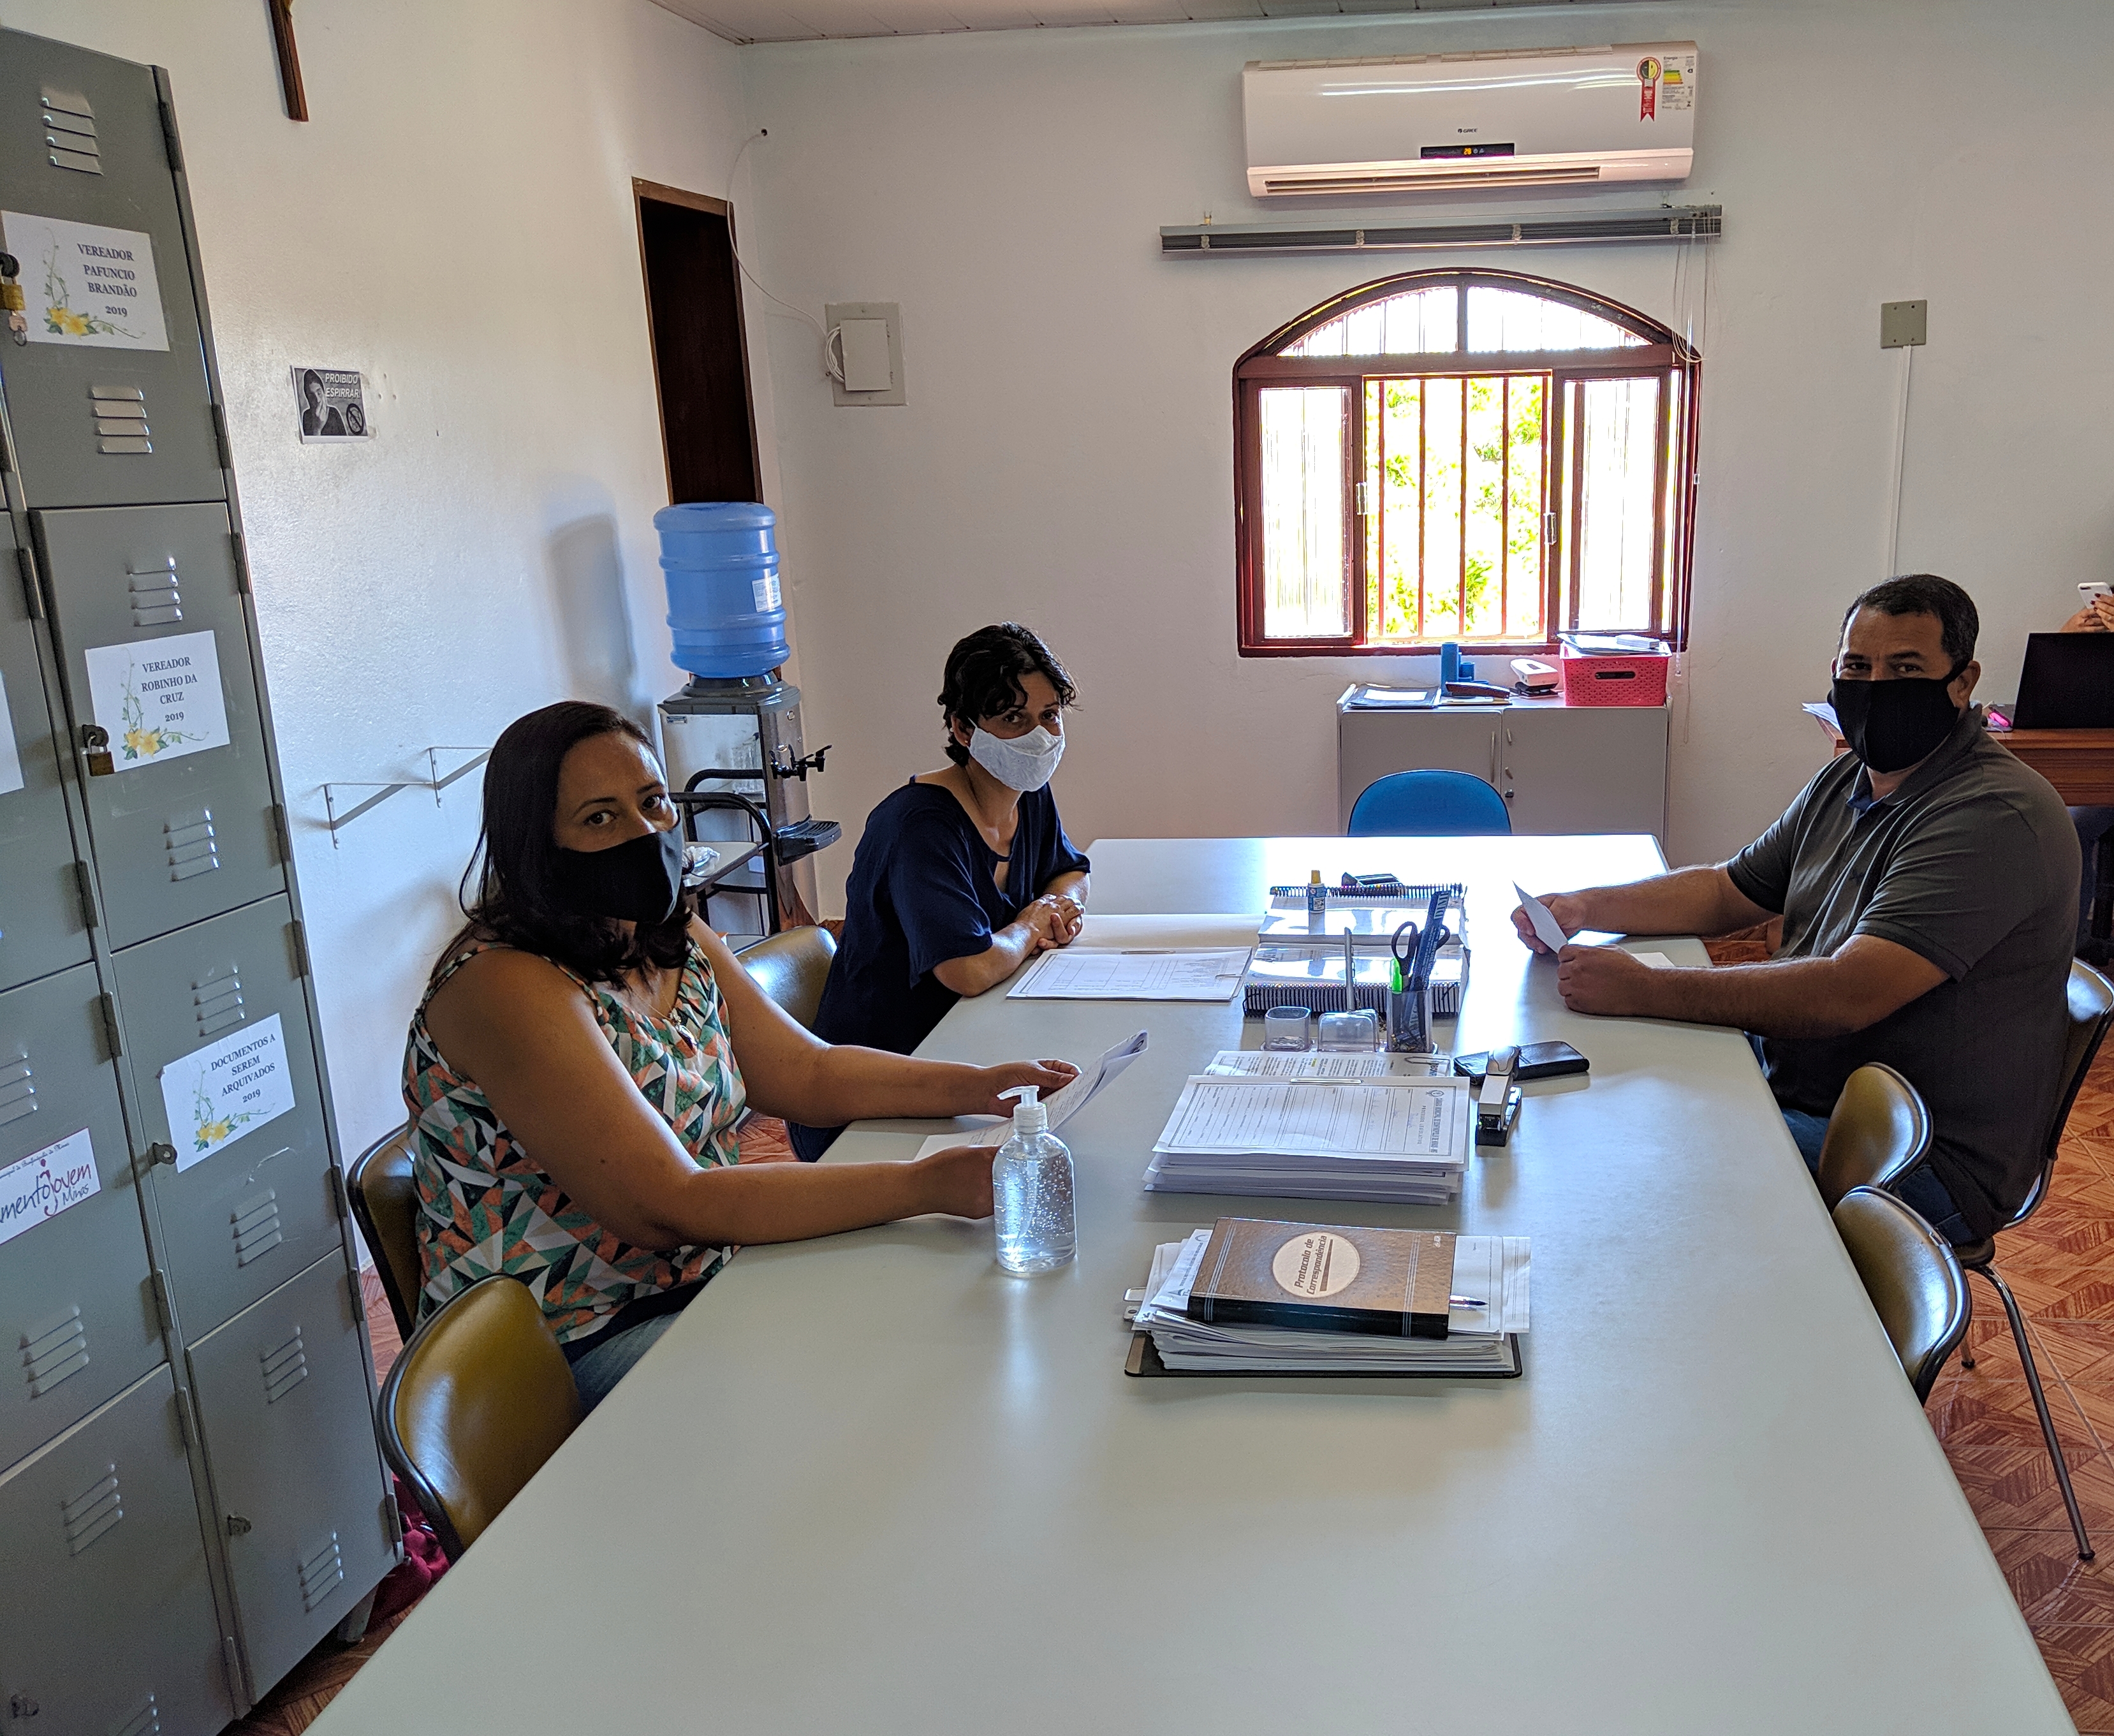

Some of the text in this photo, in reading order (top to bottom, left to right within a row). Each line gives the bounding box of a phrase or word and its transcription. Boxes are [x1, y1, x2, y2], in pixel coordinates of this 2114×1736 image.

[77, 243, 135, 261] VEREADOR
[83, 264, 136, 281] PAFUNCIO
[87, 281, 137, 297] BRANDÃO
[105, 305, 128, 317] 2019
[325, 373, 358, 384] PROIBIDO
[325, 387, 361, 399] ESPIRRAR!
[142, 656, 191, 673] VEREADOR
[141, 673, 198, 693] ROBINHO DA
[159, 691, 184, 705] CRUZ
[165, 711, 184, 723] 2019
[210, 1033, 276, 1071] DOCUMENTOS A
[231, 1055, 260, 1076] SEREM
[221, 1062, 275, 1097] ARQUIVADOS
[242, 1089, 261, 1103] 2019
[1294, 1238, 1314, 1288] Protocolo de
[1307, 1235, 1327, 1295] Correspondência
